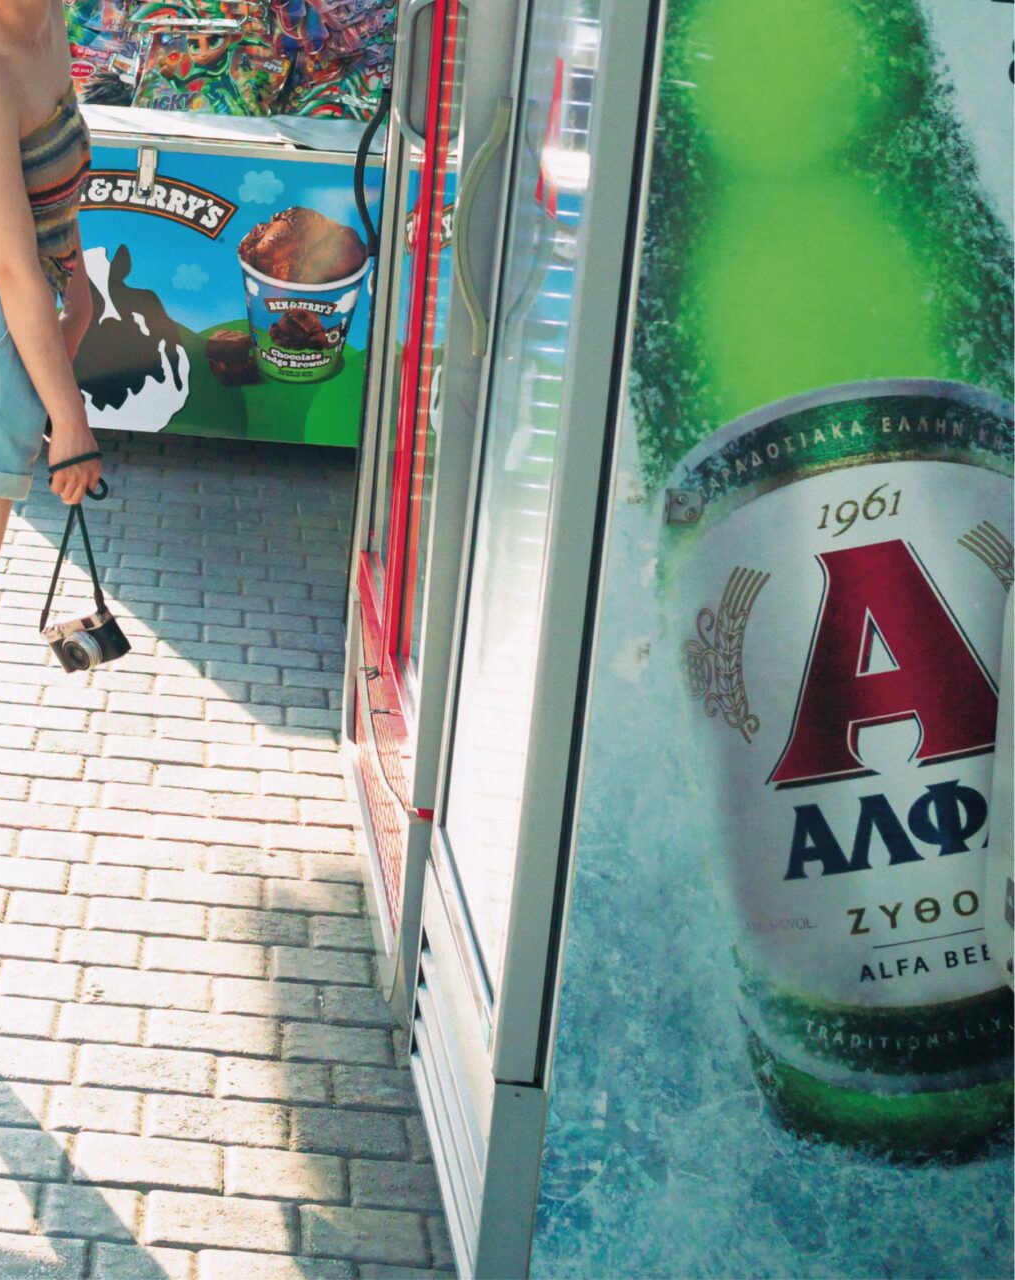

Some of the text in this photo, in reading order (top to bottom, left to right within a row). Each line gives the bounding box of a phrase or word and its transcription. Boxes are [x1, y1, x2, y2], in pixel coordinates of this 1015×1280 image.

[270, 348, 322, 361] Chocolate
[817, 482, 903, 538] 1961
[782, 778, 990, 881] ΑΛΦ
[859, 955, 931, 983] ALFA
